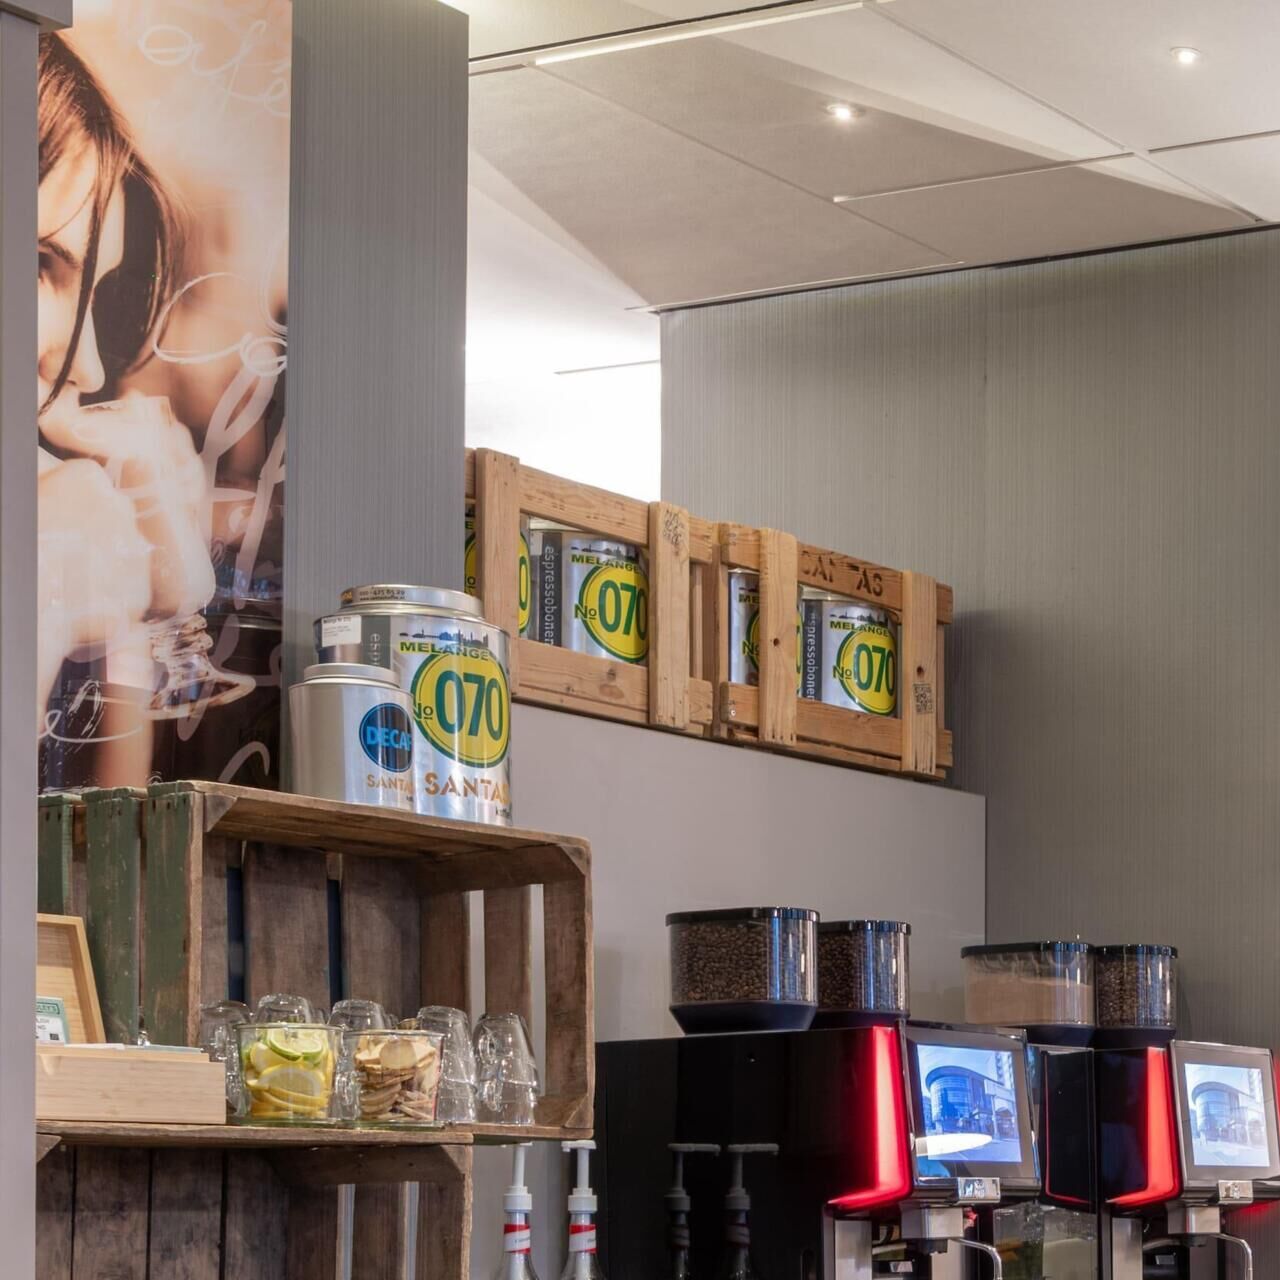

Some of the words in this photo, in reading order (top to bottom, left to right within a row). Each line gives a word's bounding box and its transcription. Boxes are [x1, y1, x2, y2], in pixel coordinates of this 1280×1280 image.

[571, 553, 640, 573] MELANGE
[598, 579, 648, 641] 070
[829, 619, 890, 638] MELANGE
[400, 640, 490, 661] MELANGE
[855, 642, 895, 697] 070
[435, 670, 504, 742] 070
